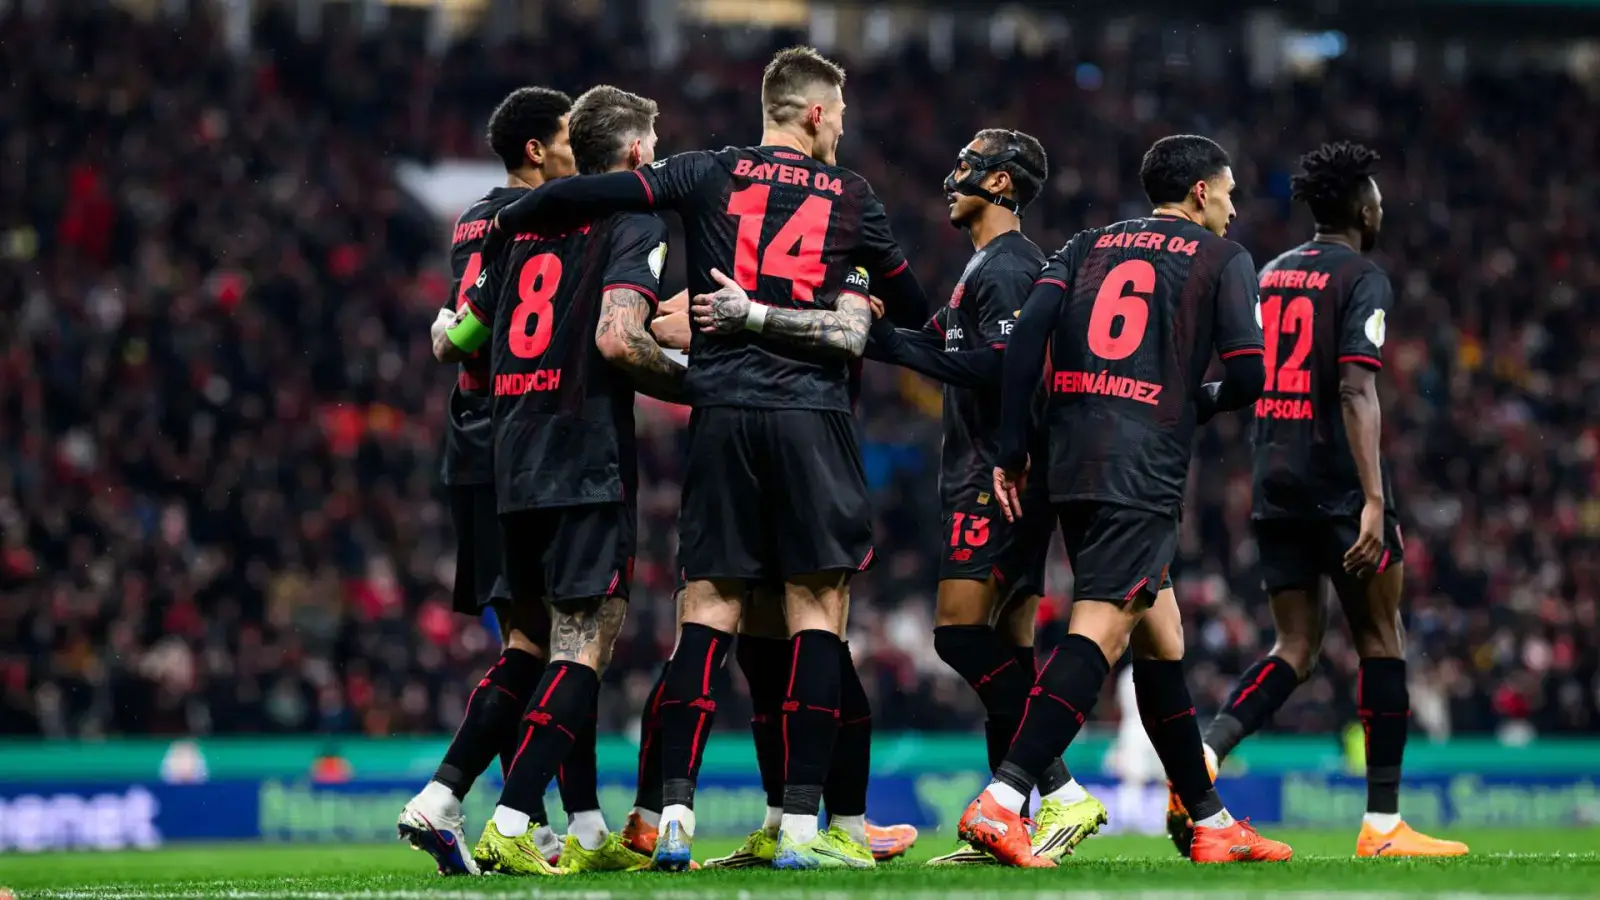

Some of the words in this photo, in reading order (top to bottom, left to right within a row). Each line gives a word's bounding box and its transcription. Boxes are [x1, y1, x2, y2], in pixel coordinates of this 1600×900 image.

[733, 158, 810, 188] BAYER
[813, 172, 844, 197] 04
[726, 181, 833, 304] 14
[1094, 230, 1167, 252] BAYER
[1167, 235, 1200, 257] 04
[1258, 269, 1308, 290] BAYER
[1305, 270, 1331, 291] 04
[508, 252, 563, 359] 8
[1086, 258, 1156, 361] 6
[997, 319, 1013, 336] Ta
[1260, 294, 1315, 394] 12
[494, 367, 562, 397] ANDRCH
[1053, 369, 1164, 407] FERNÁNDEZ
[1254, 397, 1314, 420] APSOBA
[949, 511, 991, 547] 13
